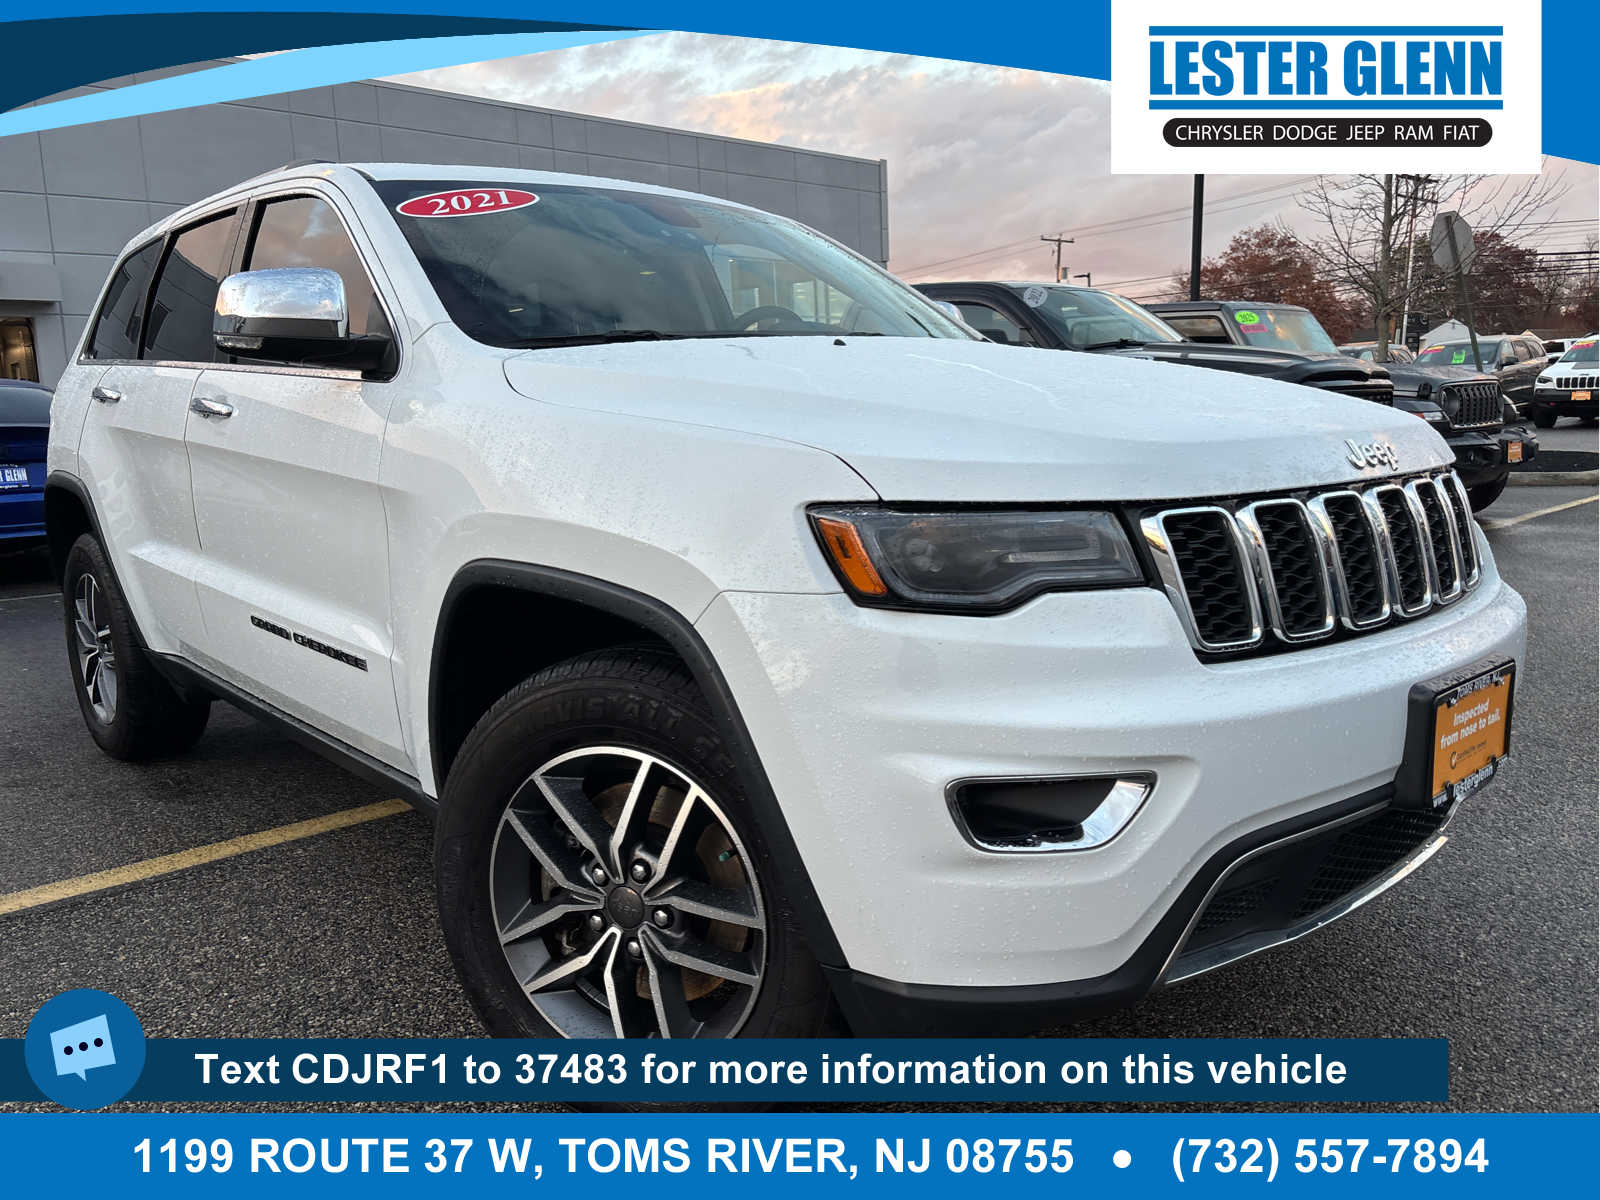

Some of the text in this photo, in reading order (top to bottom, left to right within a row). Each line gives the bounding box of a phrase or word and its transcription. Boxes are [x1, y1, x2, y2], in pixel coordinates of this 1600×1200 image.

[427, 190, 512, 215] 2021
[1343, 438, 1399, 471] Jeep
[5, 467, 28, 482] GLENN
[250, 615, 369, 673] GRAND CHEROKEE
[1453, 697, 1490, 728] Inspected
[1440, 731, 1459, 750] from
[1460, 722, 1478, 740] nose
[1478, 717, 1487, 731] to
